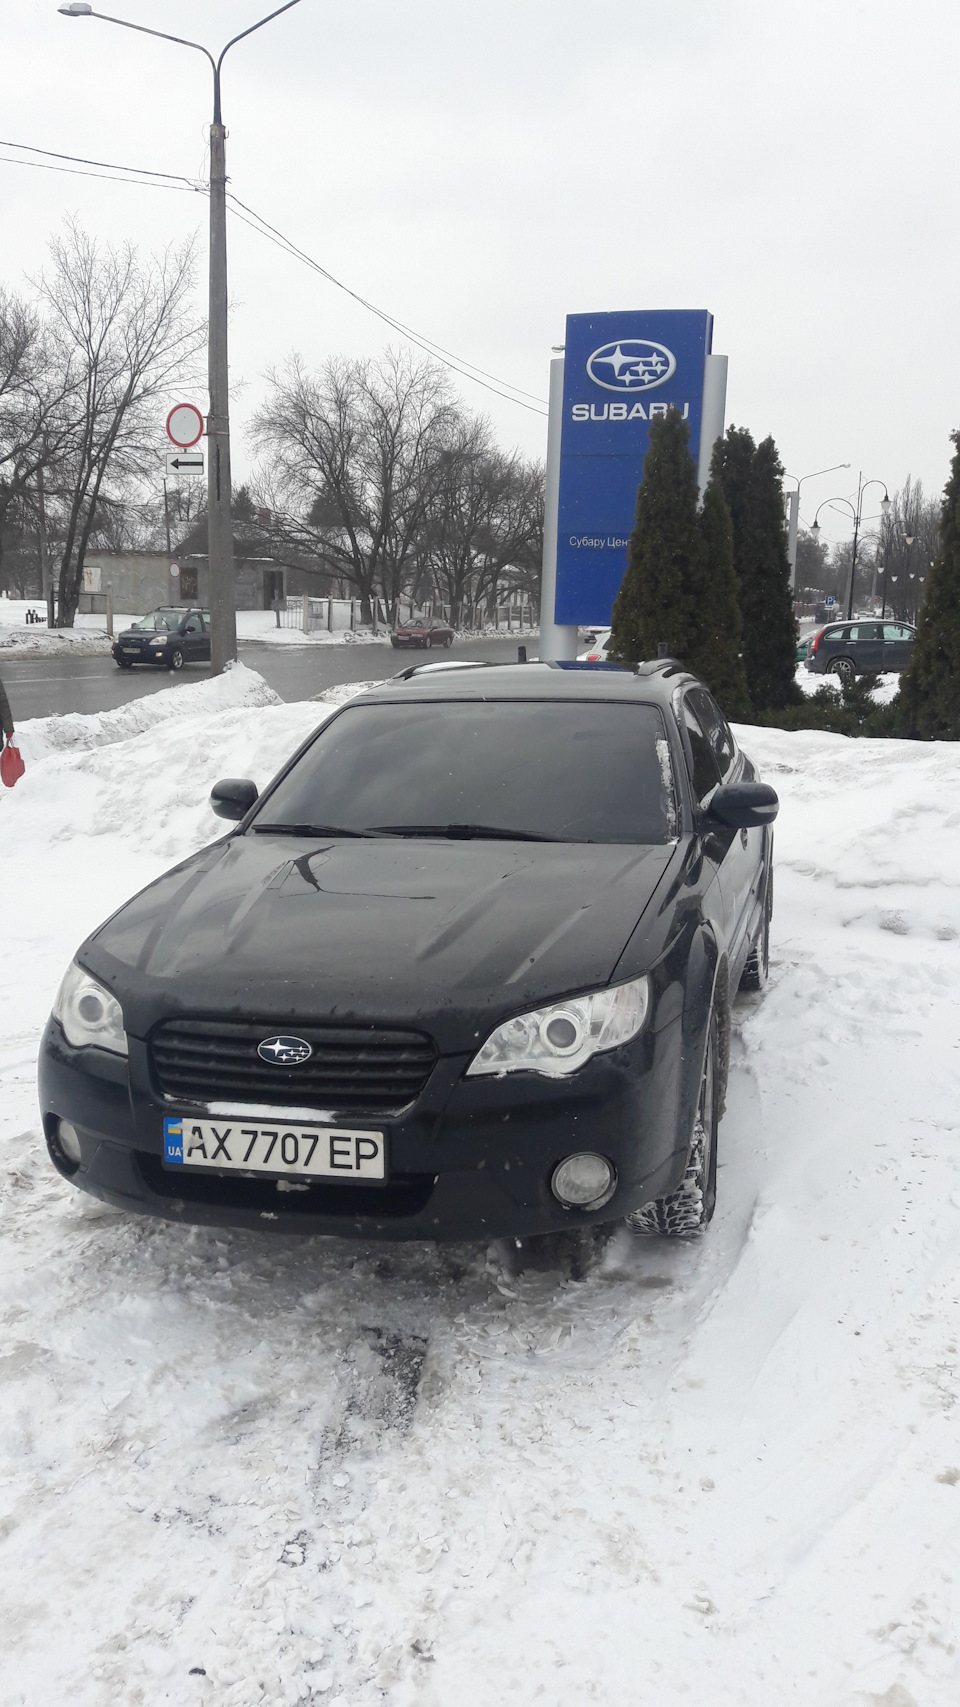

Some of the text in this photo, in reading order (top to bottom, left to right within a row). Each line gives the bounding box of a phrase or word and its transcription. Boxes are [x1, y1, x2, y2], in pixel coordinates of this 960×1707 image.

[569, 536, 606, 549] Субару
[168, 1146, 182, 1157] UA
[187, 1126, 379, 1170] AX 7707 EP
